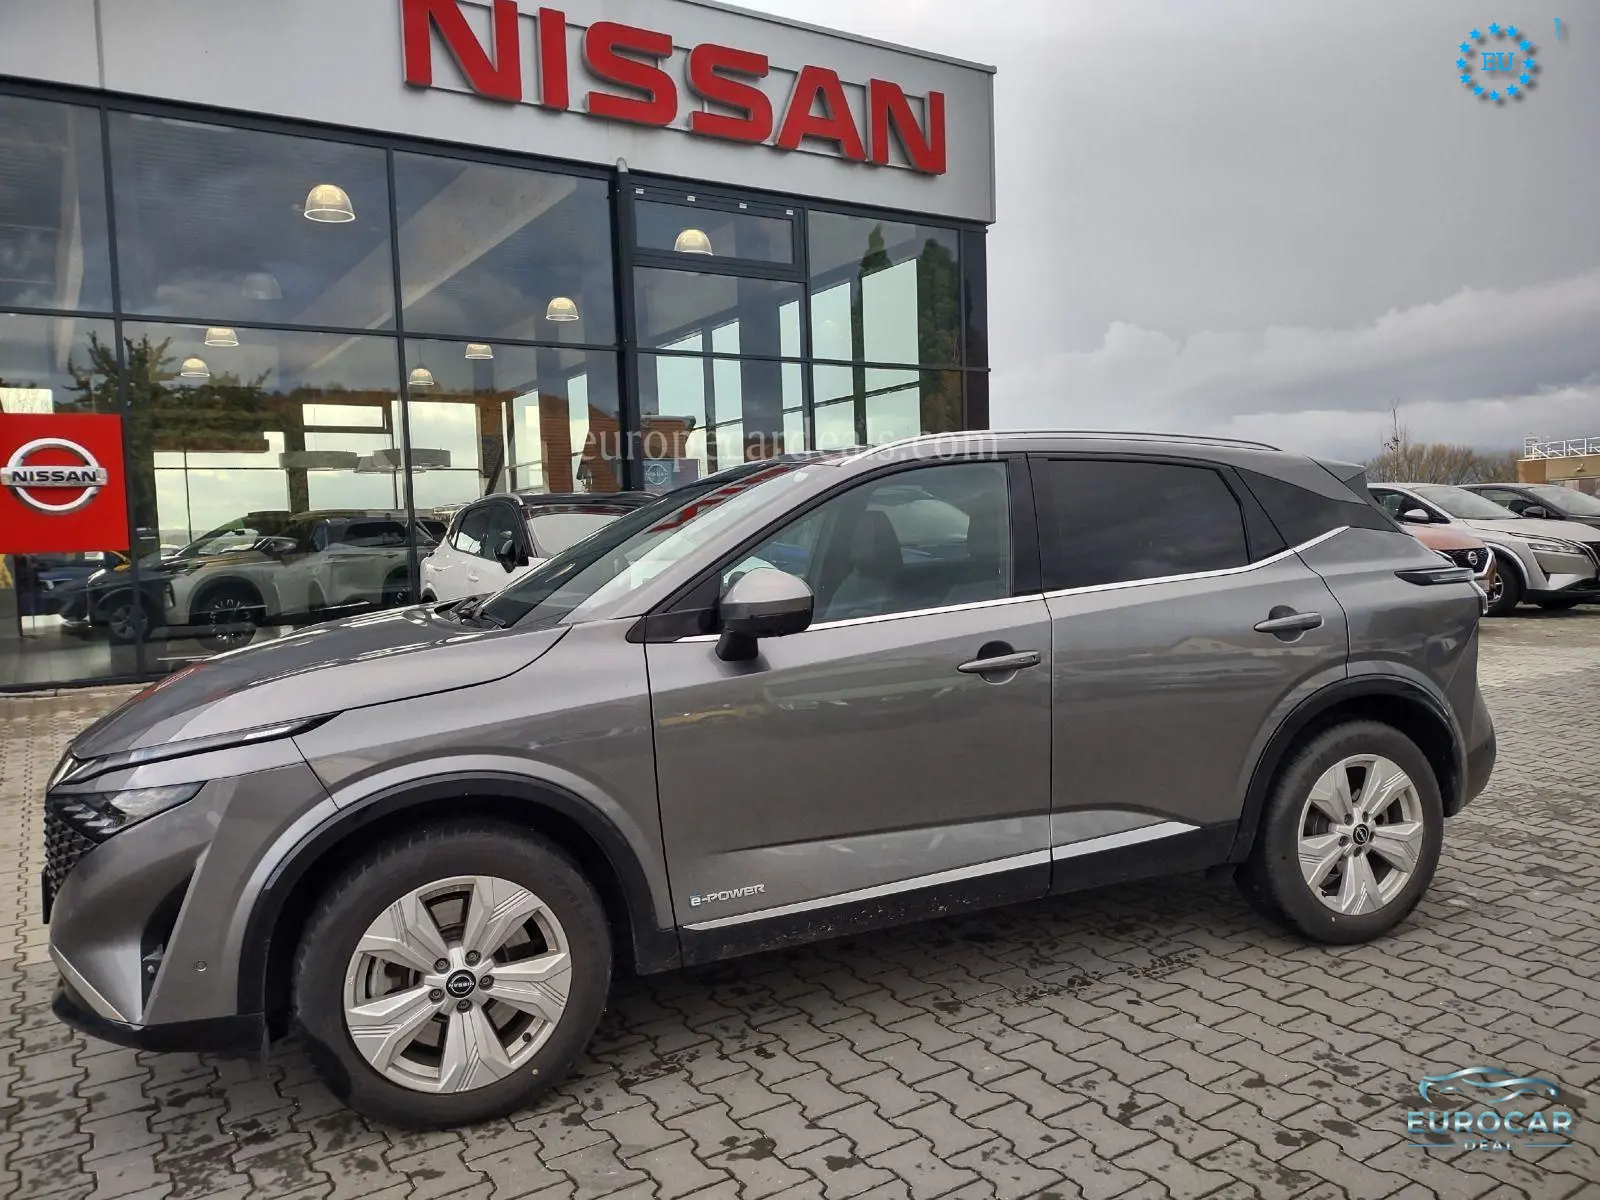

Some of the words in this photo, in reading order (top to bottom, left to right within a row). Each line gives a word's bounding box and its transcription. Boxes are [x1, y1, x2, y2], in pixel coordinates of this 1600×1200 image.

[402, 0, 947, 176] NISSAN
[12, 470, 97, 482] NISSAN
[690, 884, 766, 906] e-POWER
